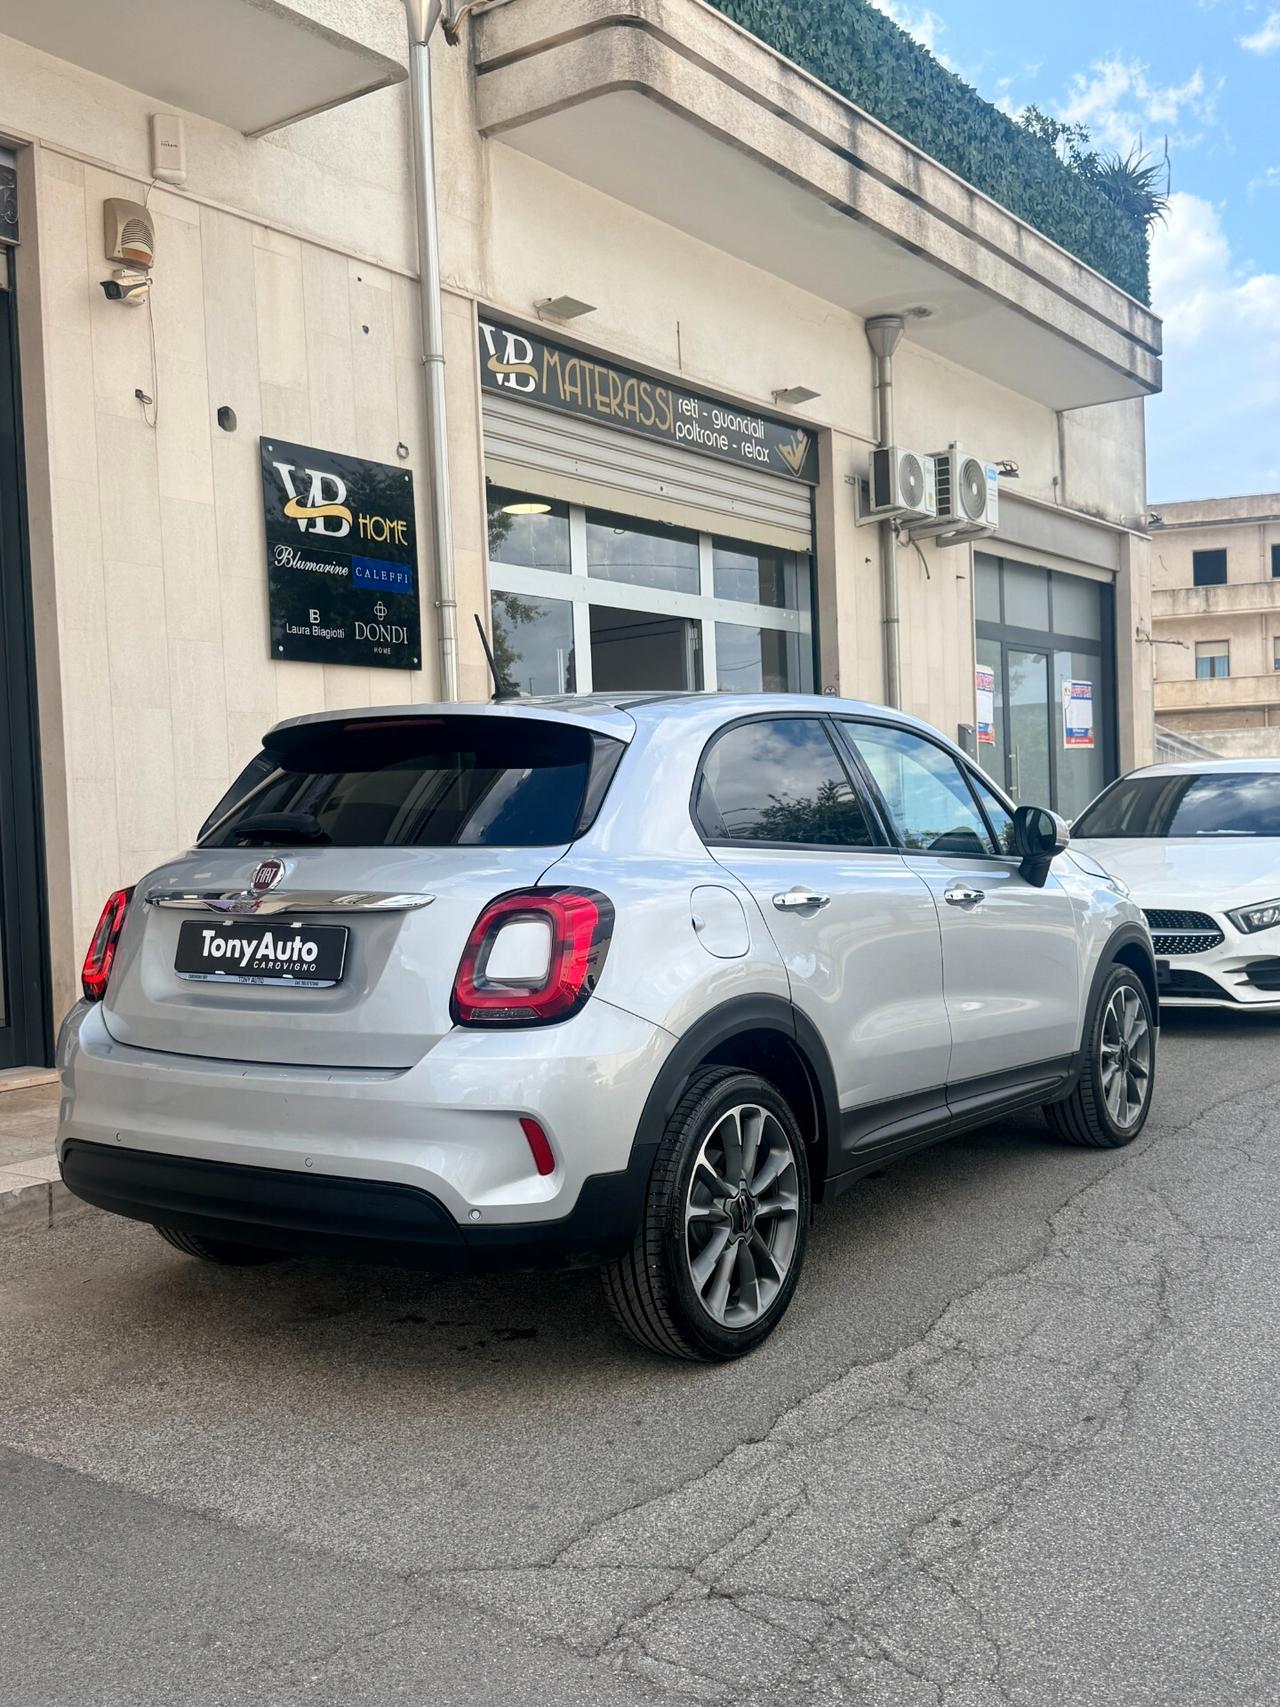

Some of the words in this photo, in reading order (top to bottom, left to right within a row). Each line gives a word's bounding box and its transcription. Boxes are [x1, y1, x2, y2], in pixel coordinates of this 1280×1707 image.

[542, 346, 674, 433] MATERASSI
[678, 398, 699, 419] reti
[712, 410, 765, 440] guanciali
[675, 420, 729, 451] poltrone
[741, 439, 770, 463] relax
[358, 512, 408, 546] HOME
[273, 544, 349, 577] Blumarine
[355, 566, 408, 584] CALEFFI
[286, 622, 311, 636] Laura
[312, 624, 345, 640] Biagiotti
[354, 621, 408, 645] DONDI
[373, 647, 391, 655] HOME
[255, 867, 279, 884] FIAT
[202, 929, 319, 968] TonyAuto
[253, 961, 317, 972] CAROVIGNO
